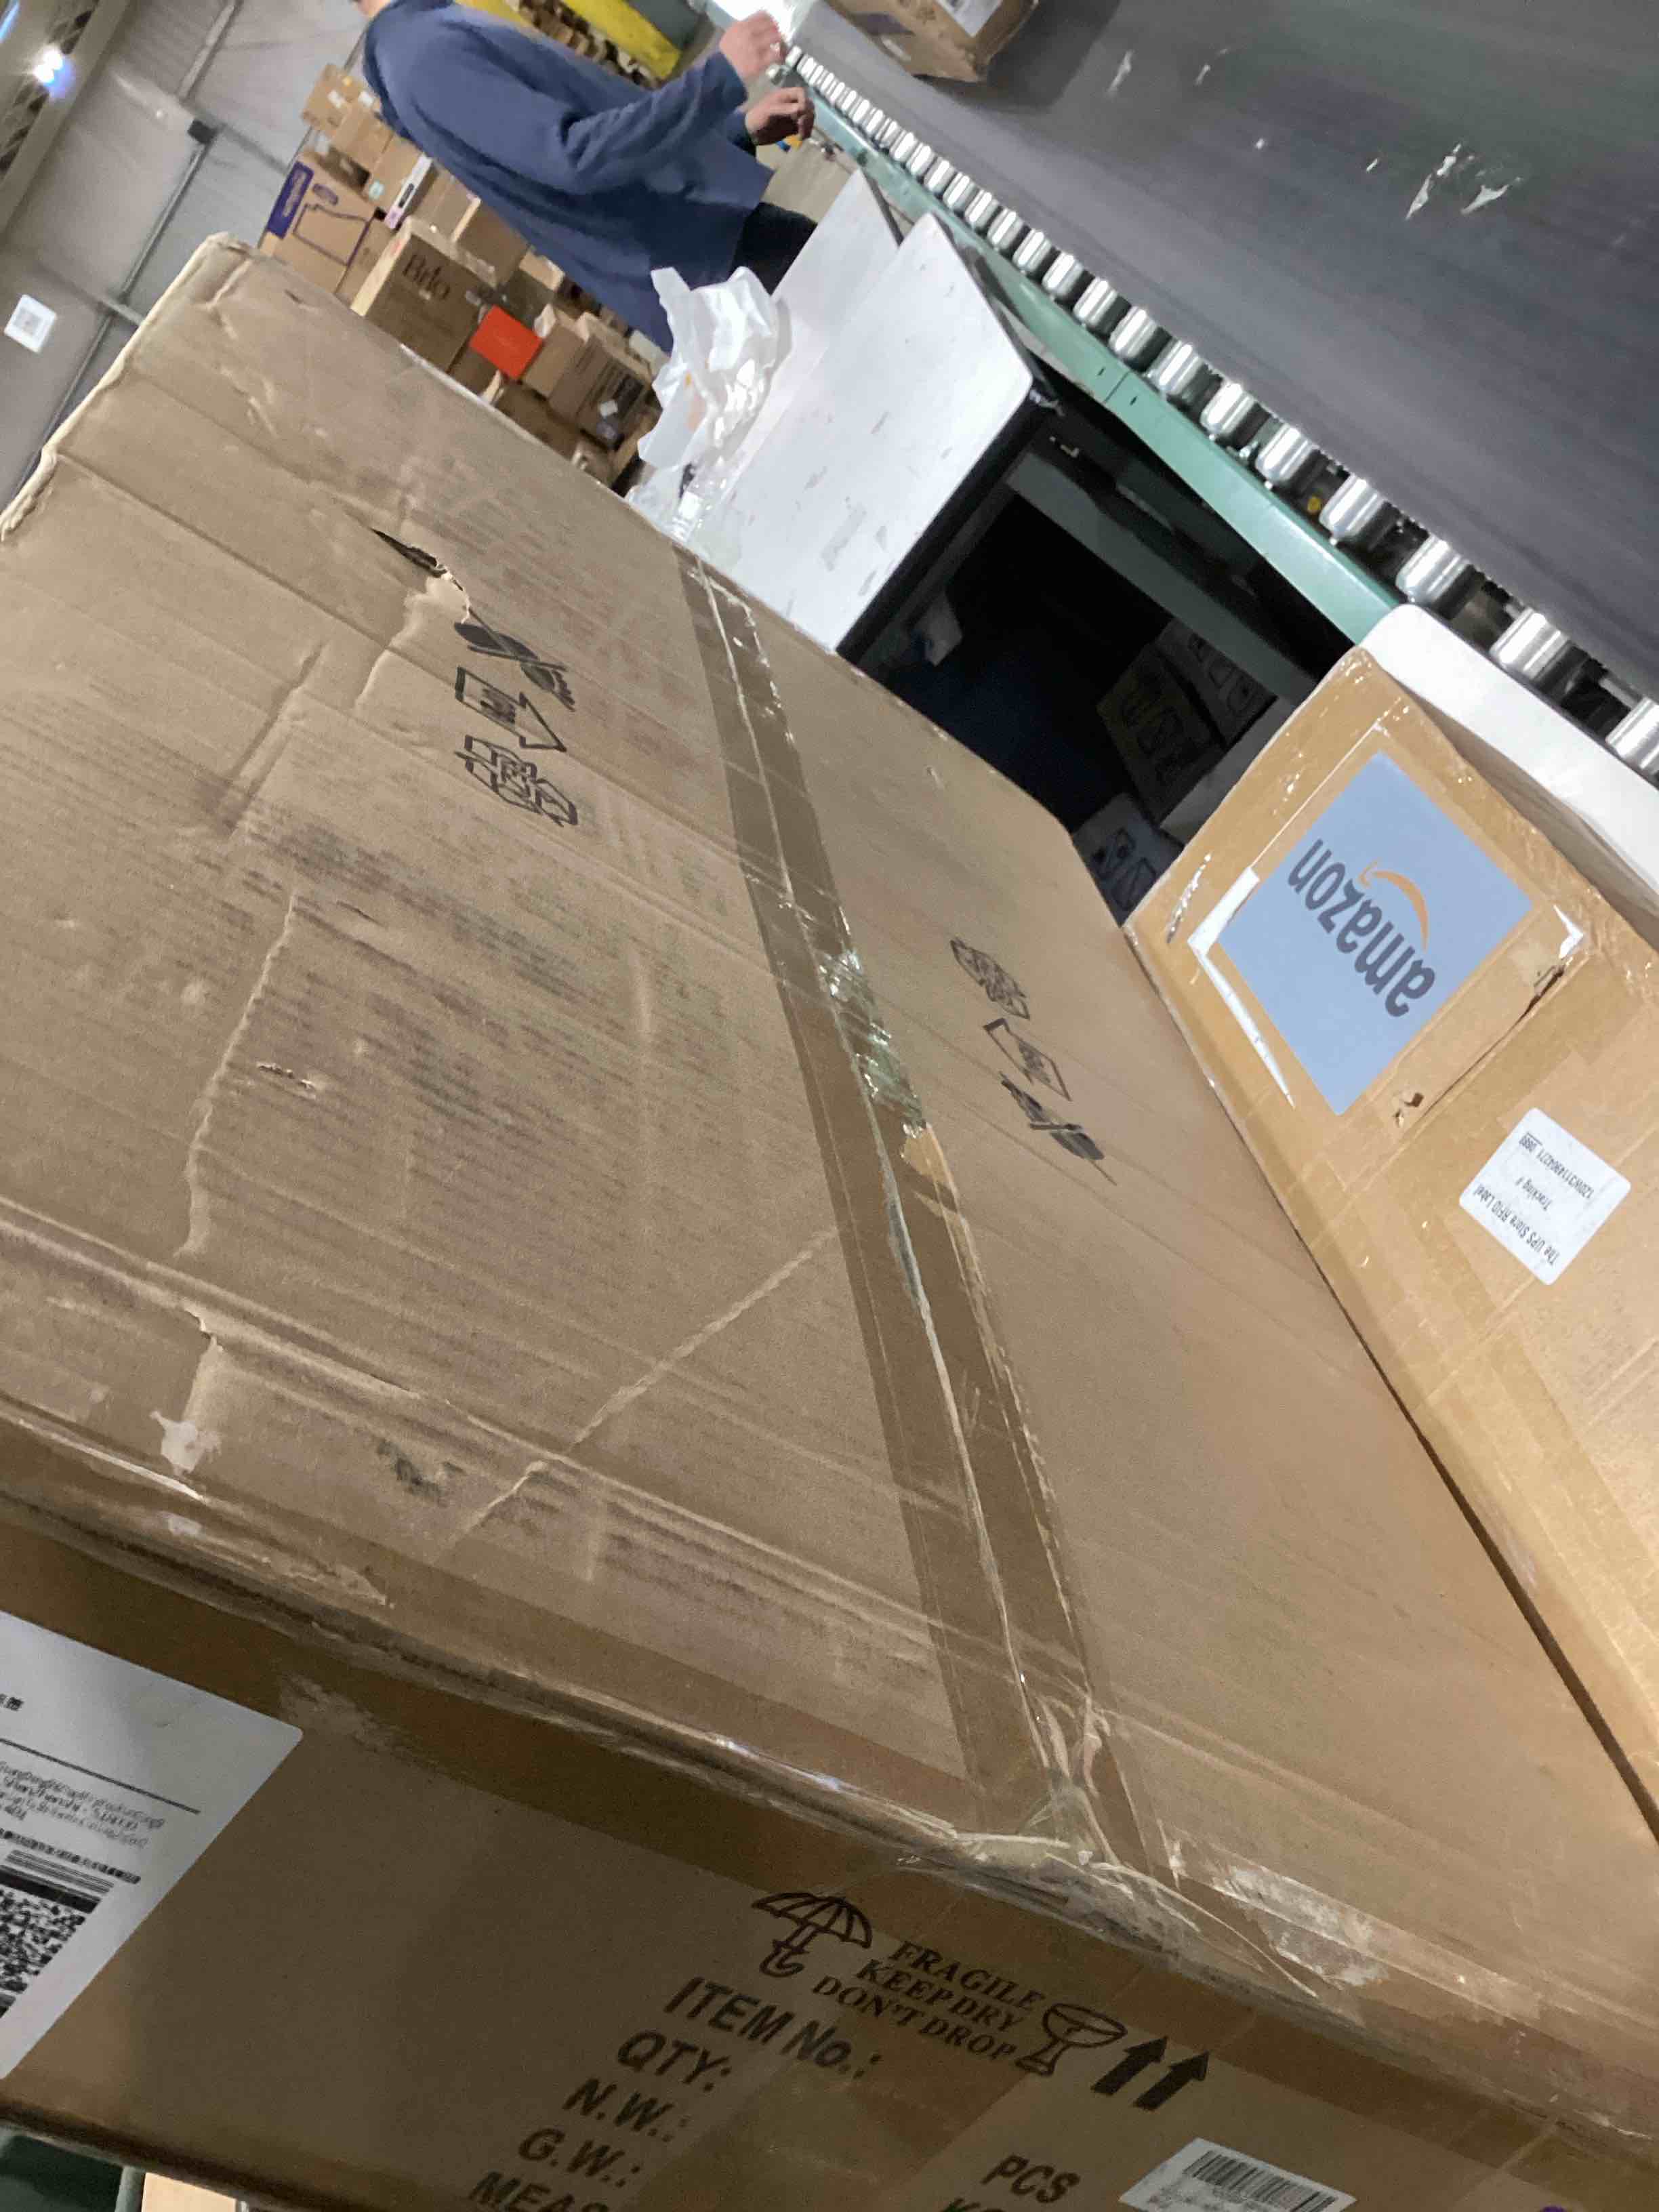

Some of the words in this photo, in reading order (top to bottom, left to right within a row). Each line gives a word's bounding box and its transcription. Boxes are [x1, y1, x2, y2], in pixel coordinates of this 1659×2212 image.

[1288, 838, 1435, 1017] amazon
[1527, 1231, 1545, 1252] UPS
[856, 1959, 954, 2005] KEEP
[948, 1995, 1025, 2032] DRY
[888, 1941, 1045, 2010] FRAGILE
[663, 1977, 794, 2045] ITEM
[813, 1976, 924, 2026] DON'T
[920, 2018, 1017, 2059] DROP
[618, 2030, 732, 2092] QTY:
[519, 2127, 640, 2188] G.W.:
[980, 2154, 1080, 2203] PCS
